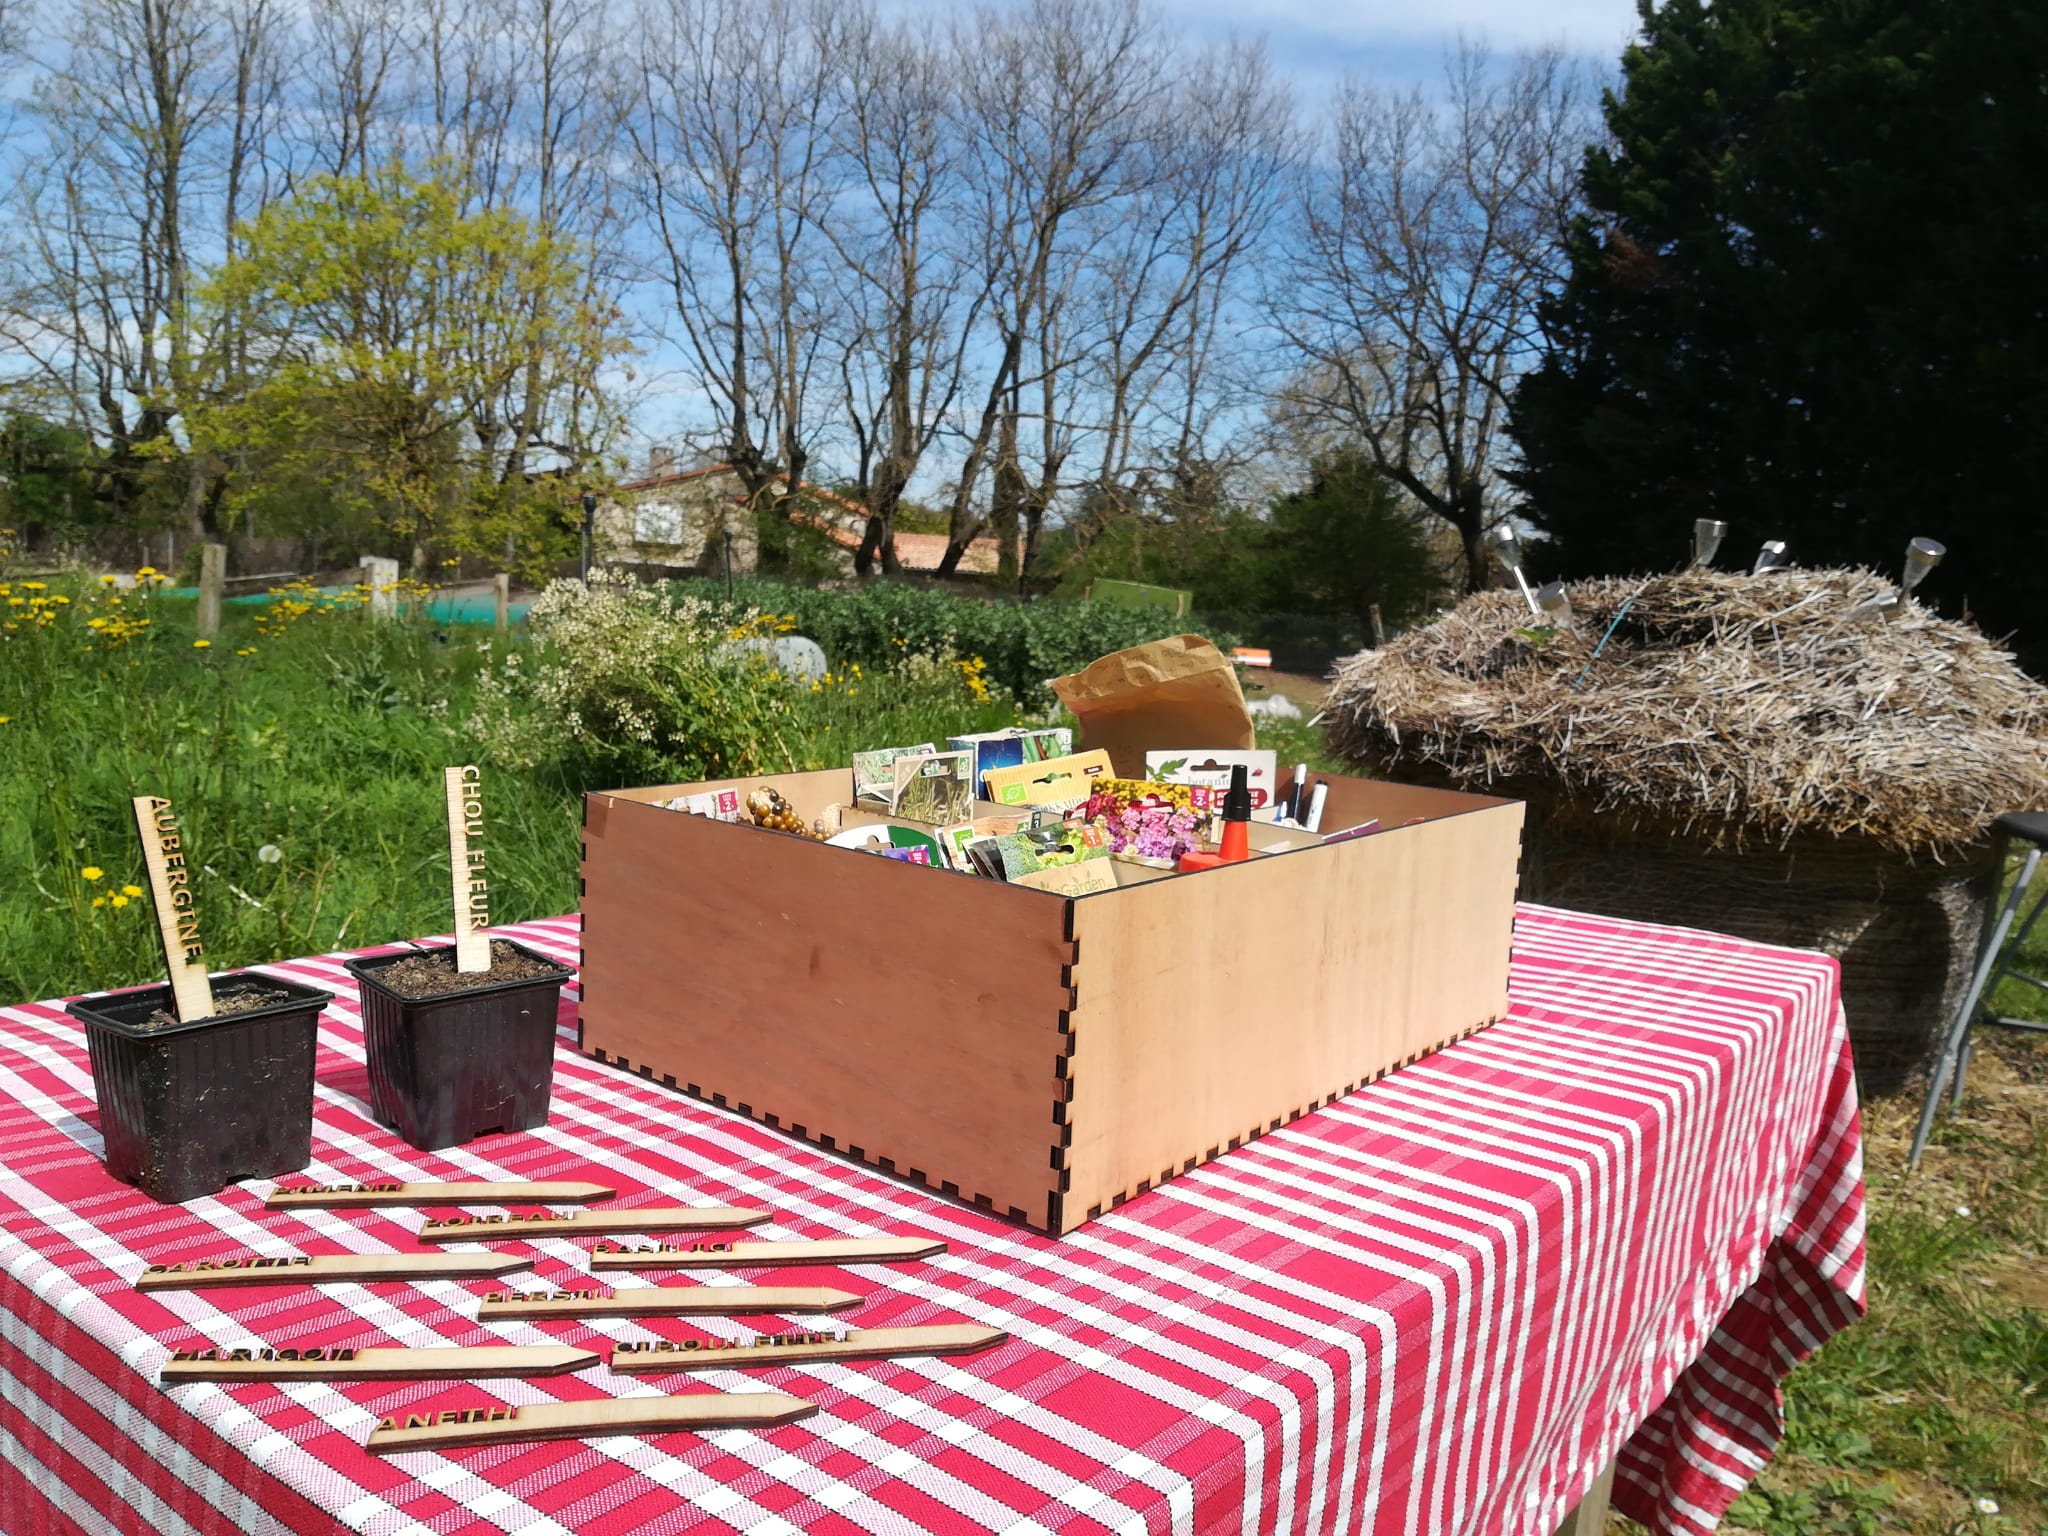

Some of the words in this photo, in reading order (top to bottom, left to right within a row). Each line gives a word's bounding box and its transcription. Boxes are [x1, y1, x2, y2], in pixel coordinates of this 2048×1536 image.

[461, 765, 484, 836] CHOU
[151, 797, 205, 970] AUBERGINE
[466, 849, 489, 935] FLEUR
[273, 1183, 403, 1196] PIMENT
[425, 1211, 571, 1229] POIREAU
[595, 1243, 730, 1254] BASILIC
[144, 1255, 312, 1275] CAROTTE
[485, 1289, 611, 1303] PERSIL
[613, 1331, 840, 1355] CIBOULETTE
[172, 1347, 353, 1362] HARICOT
[377, 1406, 513, 1432] ANETH
